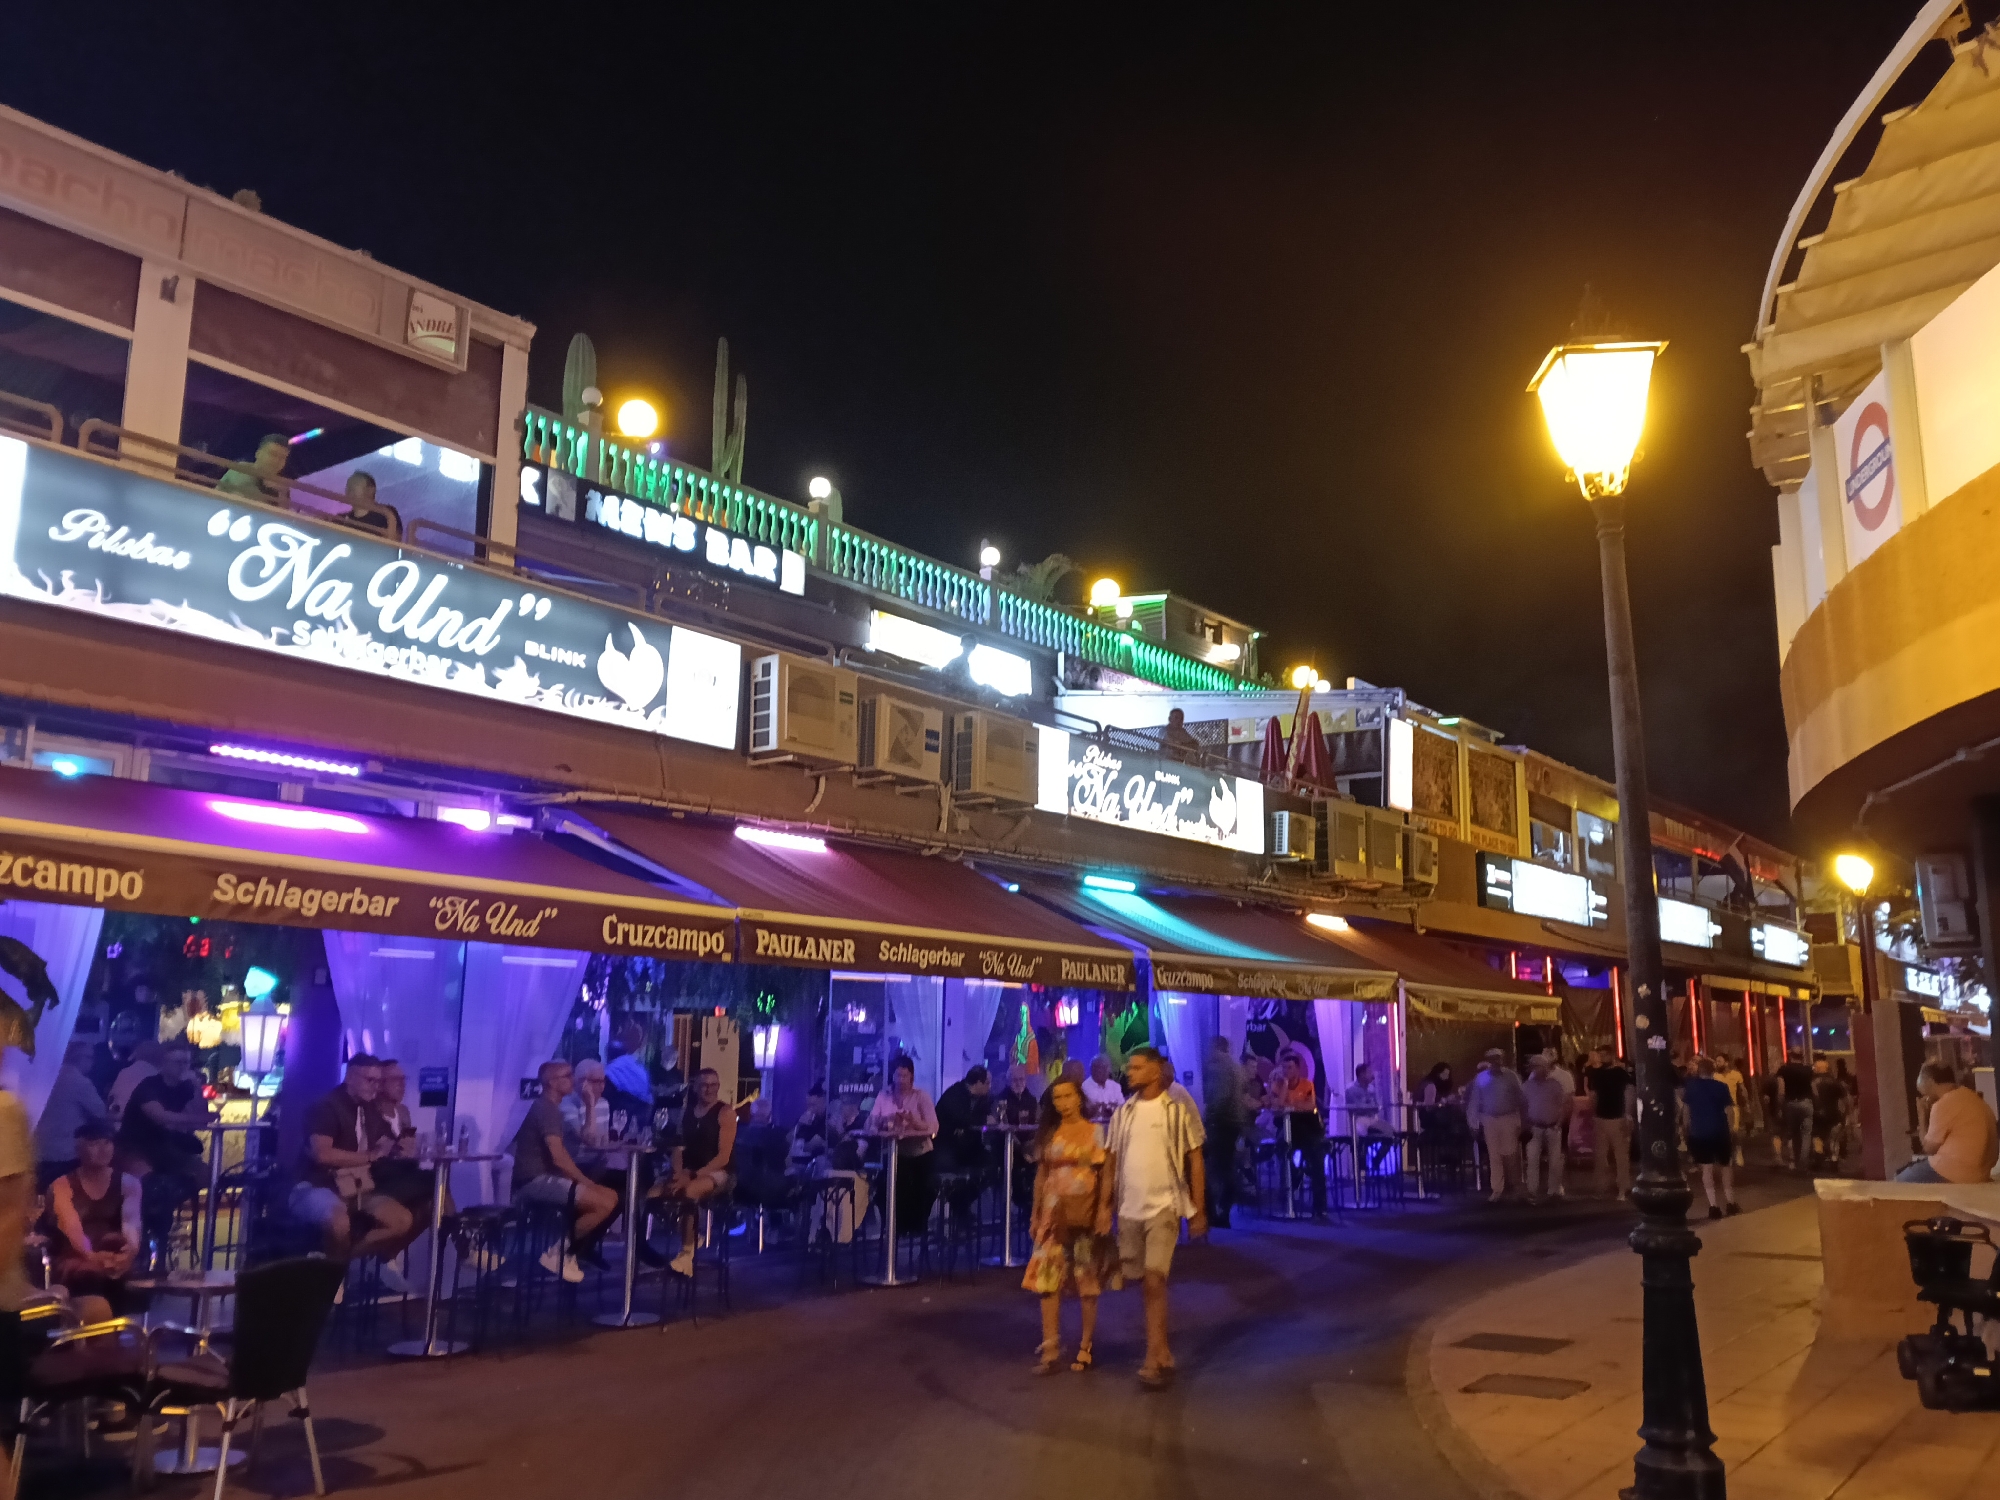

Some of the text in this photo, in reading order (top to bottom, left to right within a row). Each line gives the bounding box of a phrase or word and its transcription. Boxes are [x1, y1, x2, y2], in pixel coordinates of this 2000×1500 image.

[48, 508, 192, 570] Pilsbar
[705, 526, 778, 583] BAR
[524, 639, 587, 669] BLINK
[212, 872, 400, 917] Schlagerbar
[602, 913, 726, 957] Cruzcampo
[755, 928, 856, 965] PAULANER
[878, 940, 966, 970] Schlagerbar
[1061, 957, 1126, 985] PAULANER
[1157, 964, 1214, 992] Cruzcampo
[838, 1082, 875, 1094] ENTRADA
